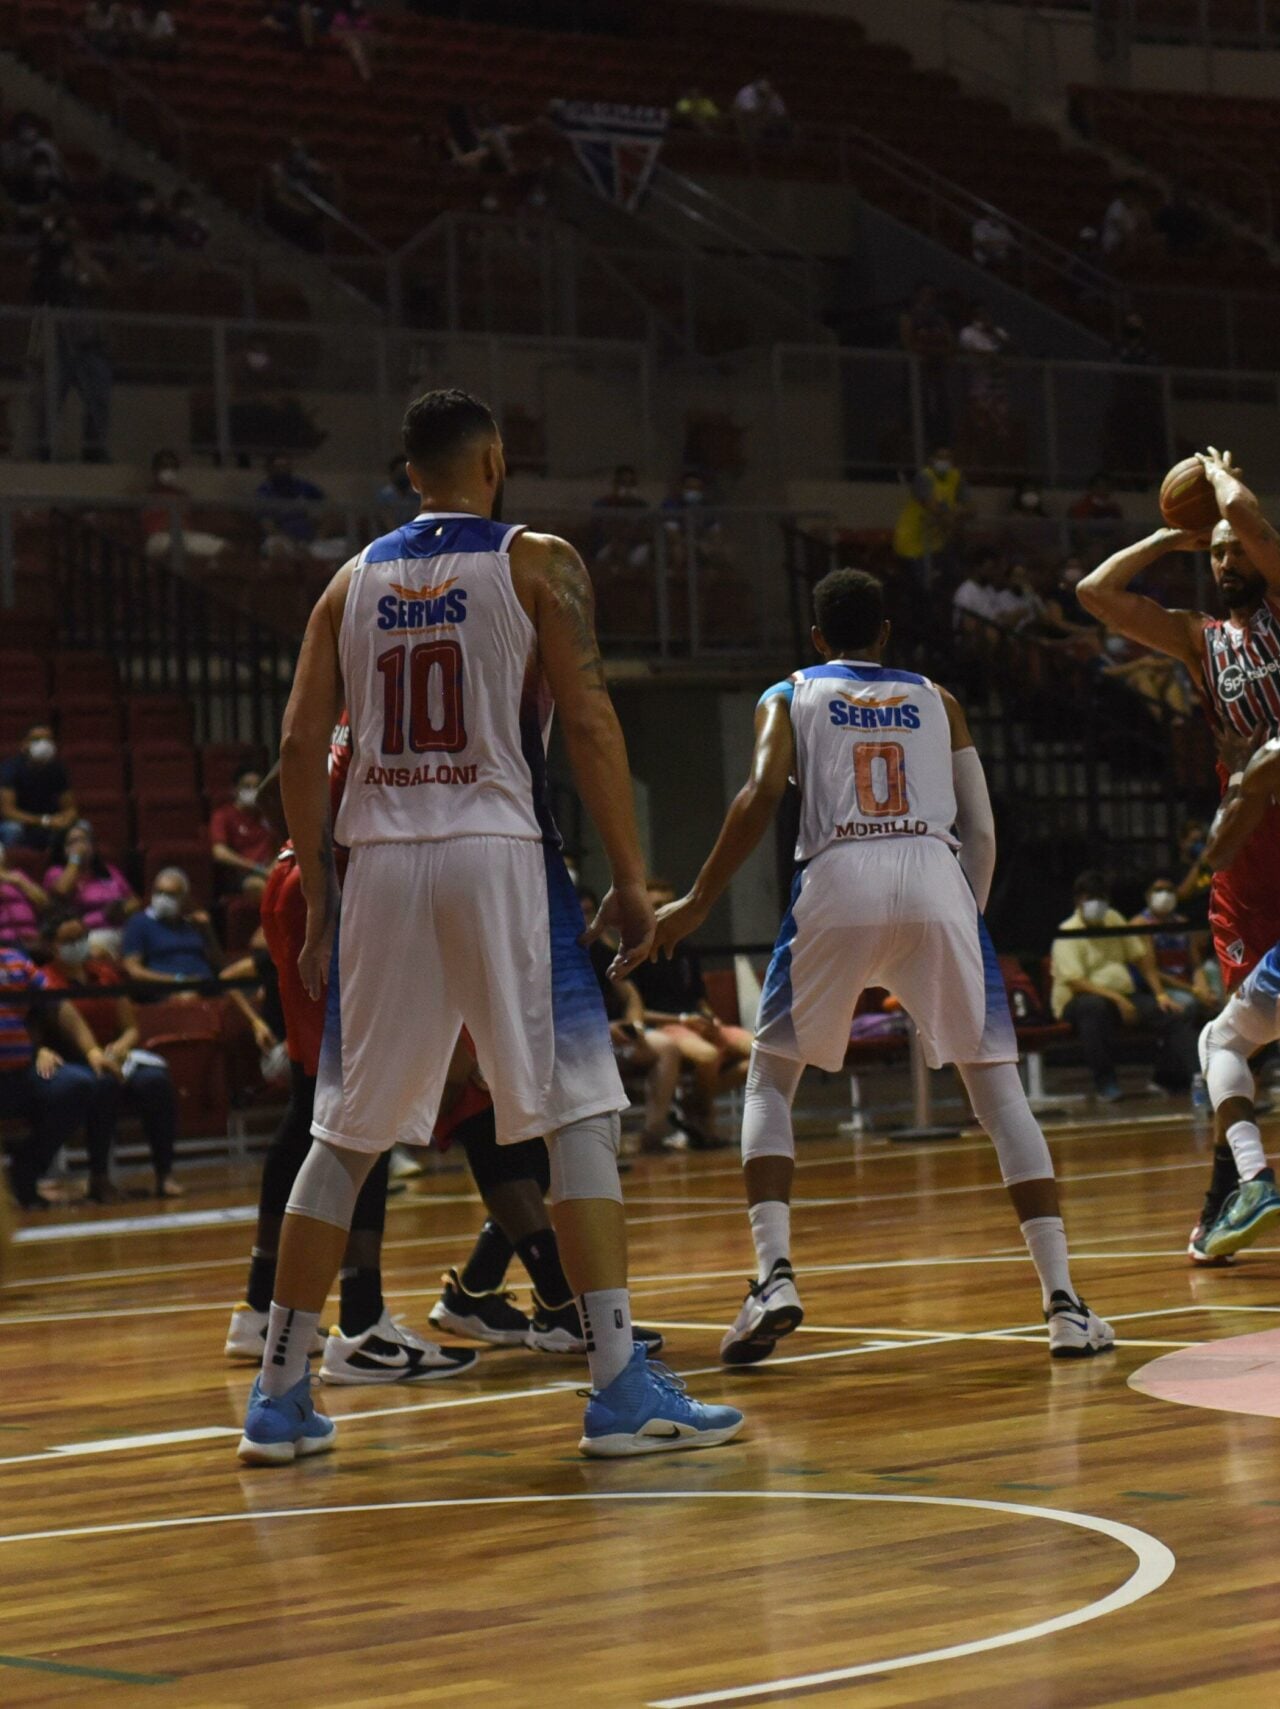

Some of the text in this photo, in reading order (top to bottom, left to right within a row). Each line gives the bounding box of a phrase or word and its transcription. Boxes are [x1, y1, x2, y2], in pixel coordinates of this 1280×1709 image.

[377, 639, 467, 755] 10
[828, 700, 921, 730] SERVIS
[363, 764, 478, 787] ANSALONI
[853, 741, 910, 818] 0
[835, 819, 928, 838] MORILLO
